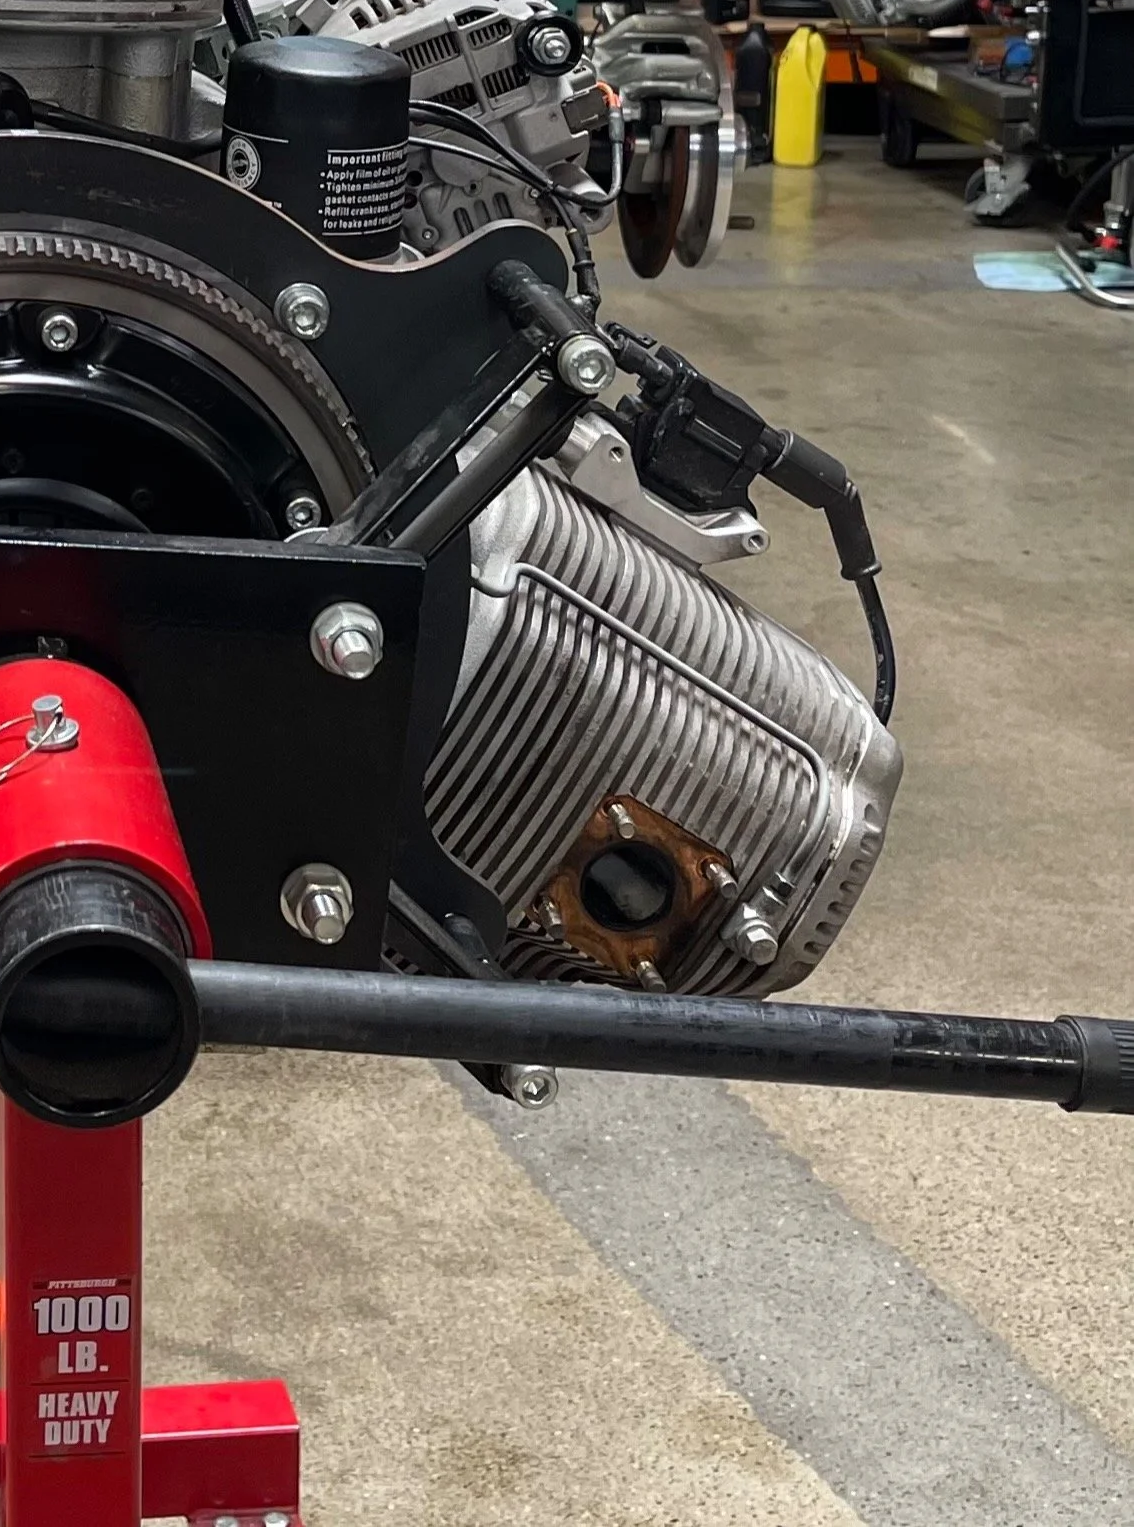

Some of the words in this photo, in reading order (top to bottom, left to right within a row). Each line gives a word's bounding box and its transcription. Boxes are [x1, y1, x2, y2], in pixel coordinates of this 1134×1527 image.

[327, 153, 381, 167] Important
[326, 170, 354, 181] Apply
[355, 169, 372, 179] film
[373, 168, 381, 178] of
[326, 181, 361, 194] Tighten
[325, 195, 356, 206] gasket
[357, 192, 388, 203] contacts
[324, 206, 349, 217] Refill
[323, 219, 337, 229] for
[339, 219, 362, 229] leaks
[363, 217, 377, 227] and
[47, 1278, 117, 1290] PITTSBURGH
[33, 1294, 130, 1335] 1000
[57, 1340, 109, 1374] LB.
[38, 1390, 119, 1419] HEAVY
[44, 1418, 111, 1446] DUTY
